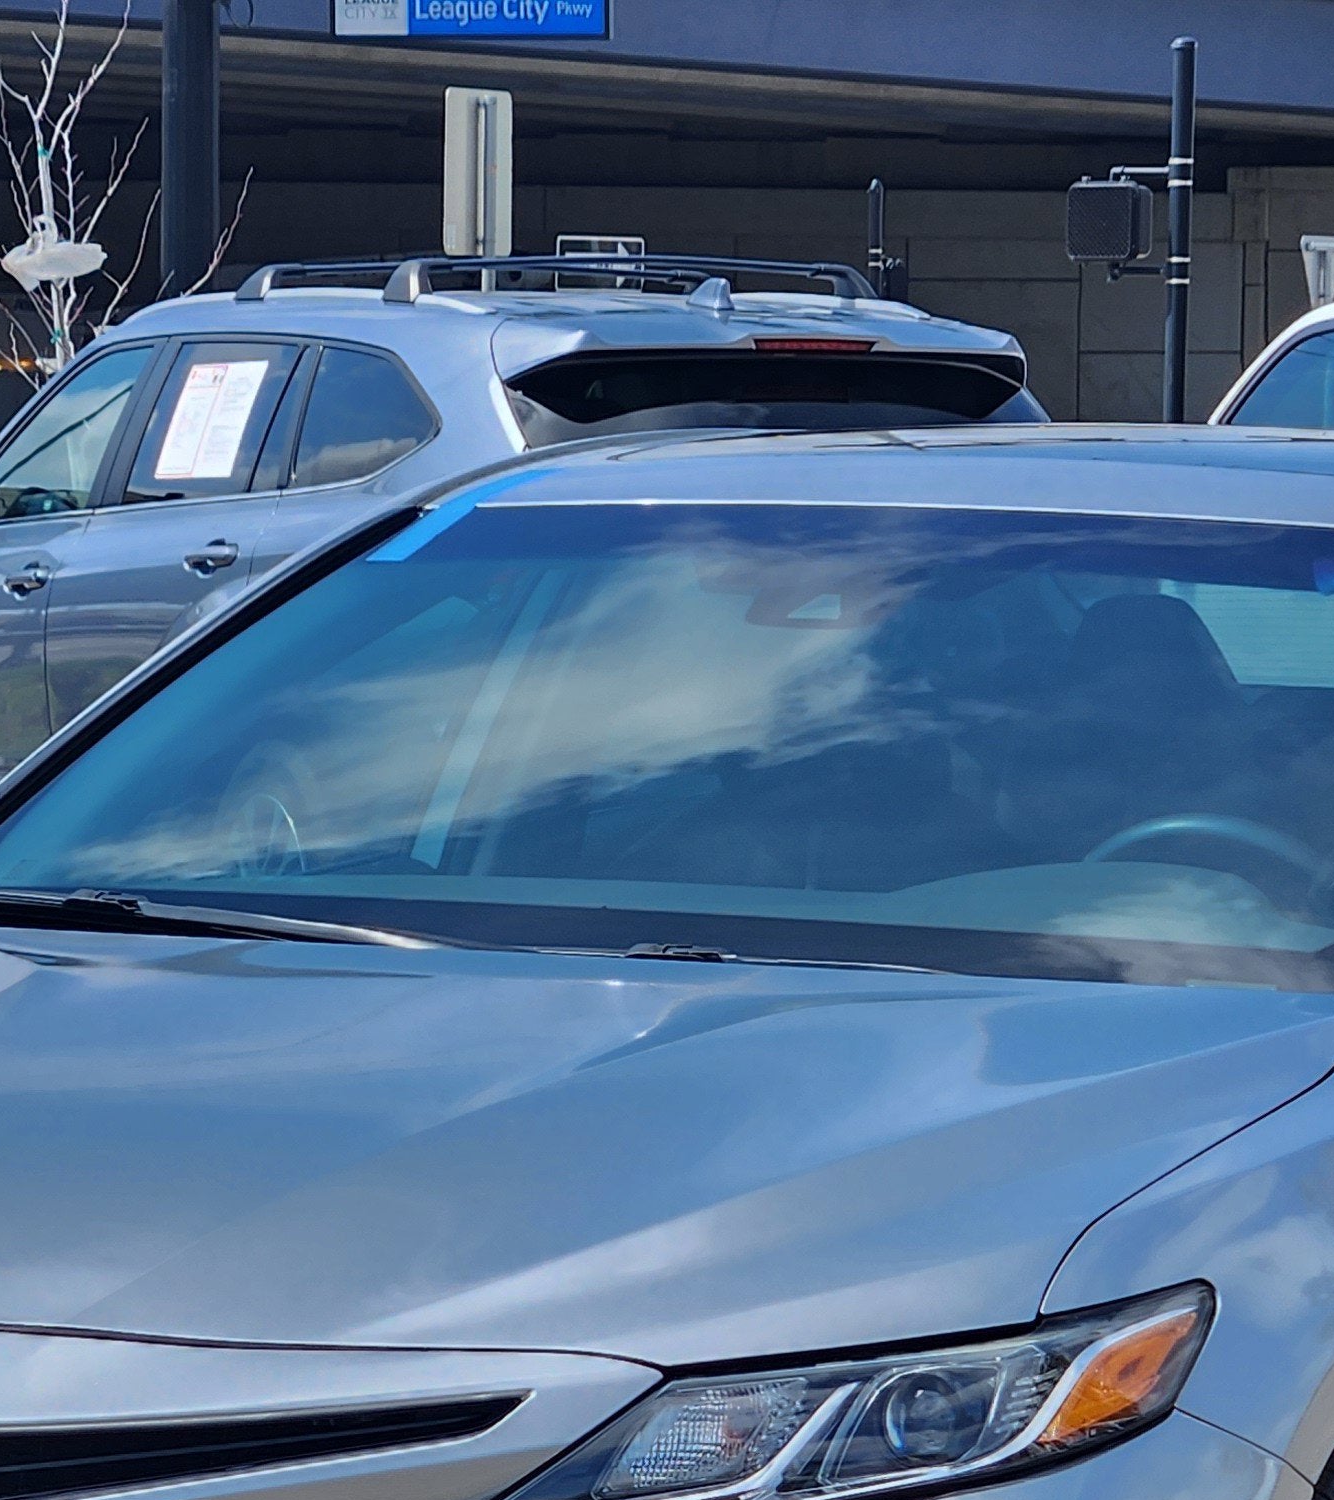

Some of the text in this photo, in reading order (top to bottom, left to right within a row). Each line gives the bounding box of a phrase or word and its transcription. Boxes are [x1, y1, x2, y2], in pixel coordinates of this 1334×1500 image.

[414, 0, 593, 27] League City Pkwy
